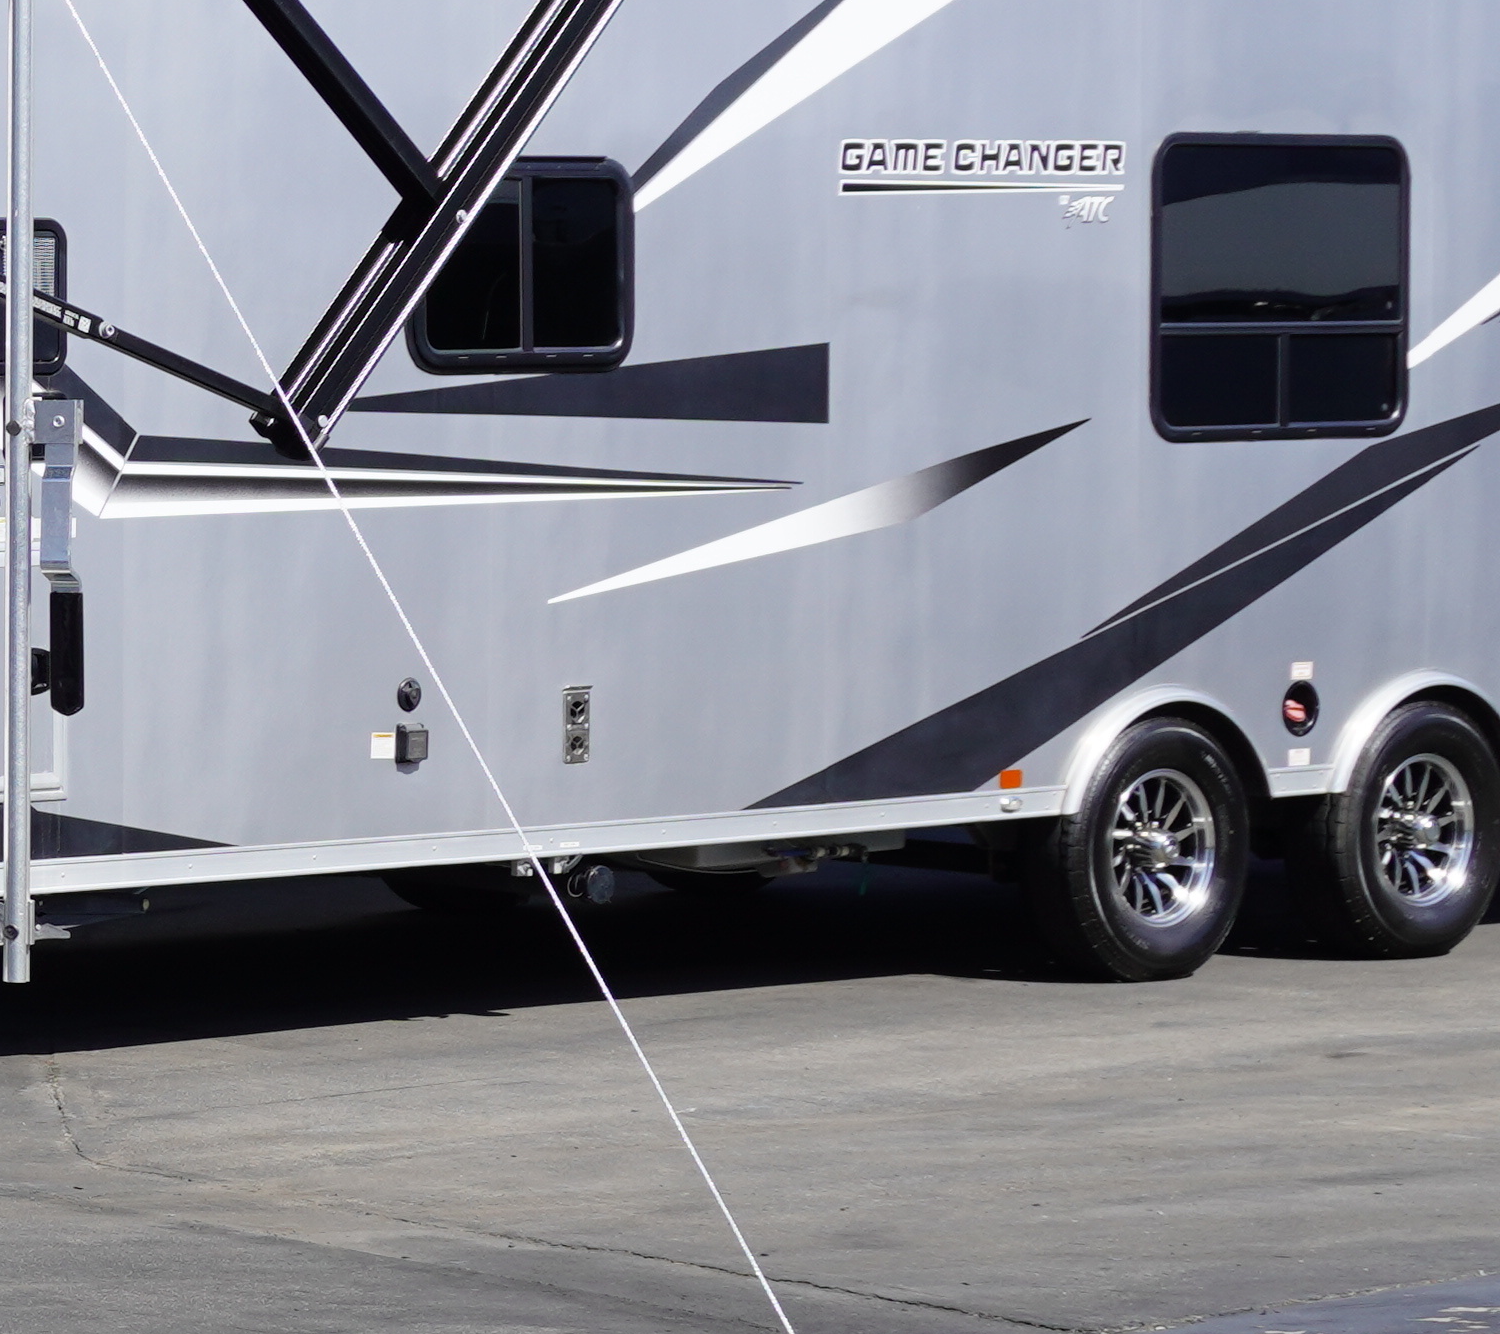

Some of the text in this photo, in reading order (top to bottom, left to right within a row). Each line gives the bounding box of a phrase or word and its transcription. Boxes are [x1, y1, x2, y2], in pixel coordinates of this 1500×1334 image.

[840, 139, 1126, 175] GAME CHANGER
[1072, 195, 1114, 223] ATC
